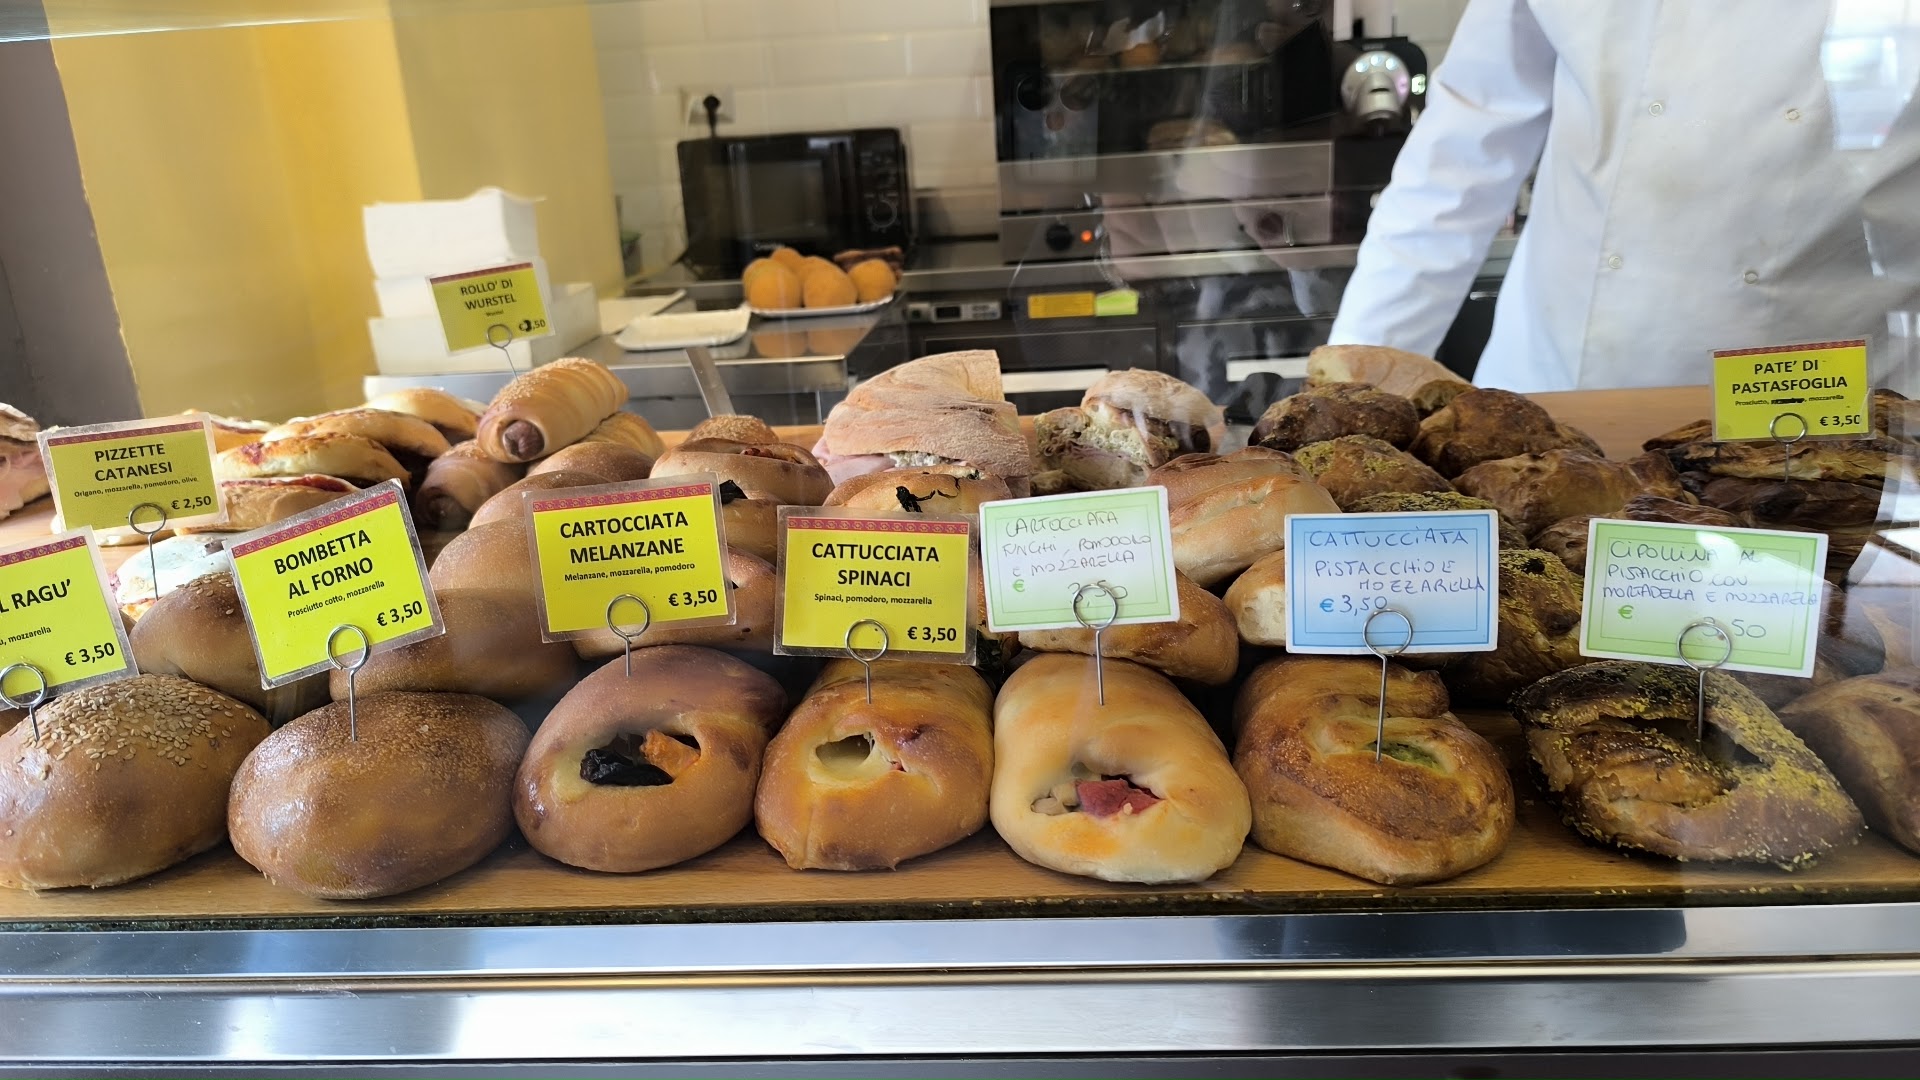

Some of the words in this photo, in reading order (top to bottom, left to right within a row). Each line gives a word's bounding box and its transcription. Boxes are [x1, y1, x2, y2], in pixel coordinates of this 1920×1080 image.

[460, 281, 498, 296] ROLLO'
[502, 279, 513, 290] DI
[465, 293, 517, 310] WURSTEL
[1754, 360, 1797, 375] PATE'
[1803, 359, 1819, 371] DI
[1732, 376, 1848, 394] PASTASFOGLIA
[1820, 416, 1828, 426] €
[1832, 414, 1860, 427] 3,50
[94, 443, 166, 462] PIZZETTE
[94, 461, 173, 482] CATANESI
[74, 488, 104, 498] Origano,
[104, 483, 143, 494] mozzarella,
[144, 478, 181, 490] pomodoro,
[182, 475, 198, 484] olive
[171, 500, 181, 510] €
[183, 495, 212, 509] 2,50
[560, 511, 689, 539] CARTOCCIATA
[1005, 511, 1119, 538] CARTOCCIATA
[274, 529, 372, 575] BOMBETTA
[570, 538, 685, 564] MELANZANE
[810, 542, 940, 562] CATTUCCIATA
[564, 570, 609, 582] Melanzane,
[609, 566, 653, 577] mozzarella,
[654, 562, 696, 575] pomodoro
[1031, 550, 1136, 577] MOZZARELLA
[1441, 560, 1456, 574] E
[288, 579, 310, 600] AL
[311, 557, 373, 592] FORNO
[837, 569, 911, 587] SPINACI
[1012, 579, 1026, 592] €
[1359, 576, 1486, 594] MOZZARELLA
[11, 578, 71, 610] RAGU'
[287, 600, 324, 619] Prosciutto
[324, 594, 346, 606] cotto,
[346, 580, 385, 600] mozzarella
[668, 593, 679, 607] €
[683, 589, 718, 608] 3,50
[814, 592, 844, 603] Spinaci,
[845, 594, 889, 605] pomodoro,
[890, 595, 933, 605] mozzarella
[1602, 585, 1695, 602] MORTADELLA
[1706, 591, 1717, 602] E
[376, 612, 388, 627] €
[391, 600, 423, 624] 3,50
[1319, 598, 1335, 613] €
[1339, 594, 1388, 616] 3,50
[1618, 604, 1634, 620] €
[8, 626, 52, 643] mozzarella
[907, 626, 917, 640] €
[921, 626, 957, 643] 3,50
[65, 651, 77, 666] €
[79, 642, 115, 665] 3,50
